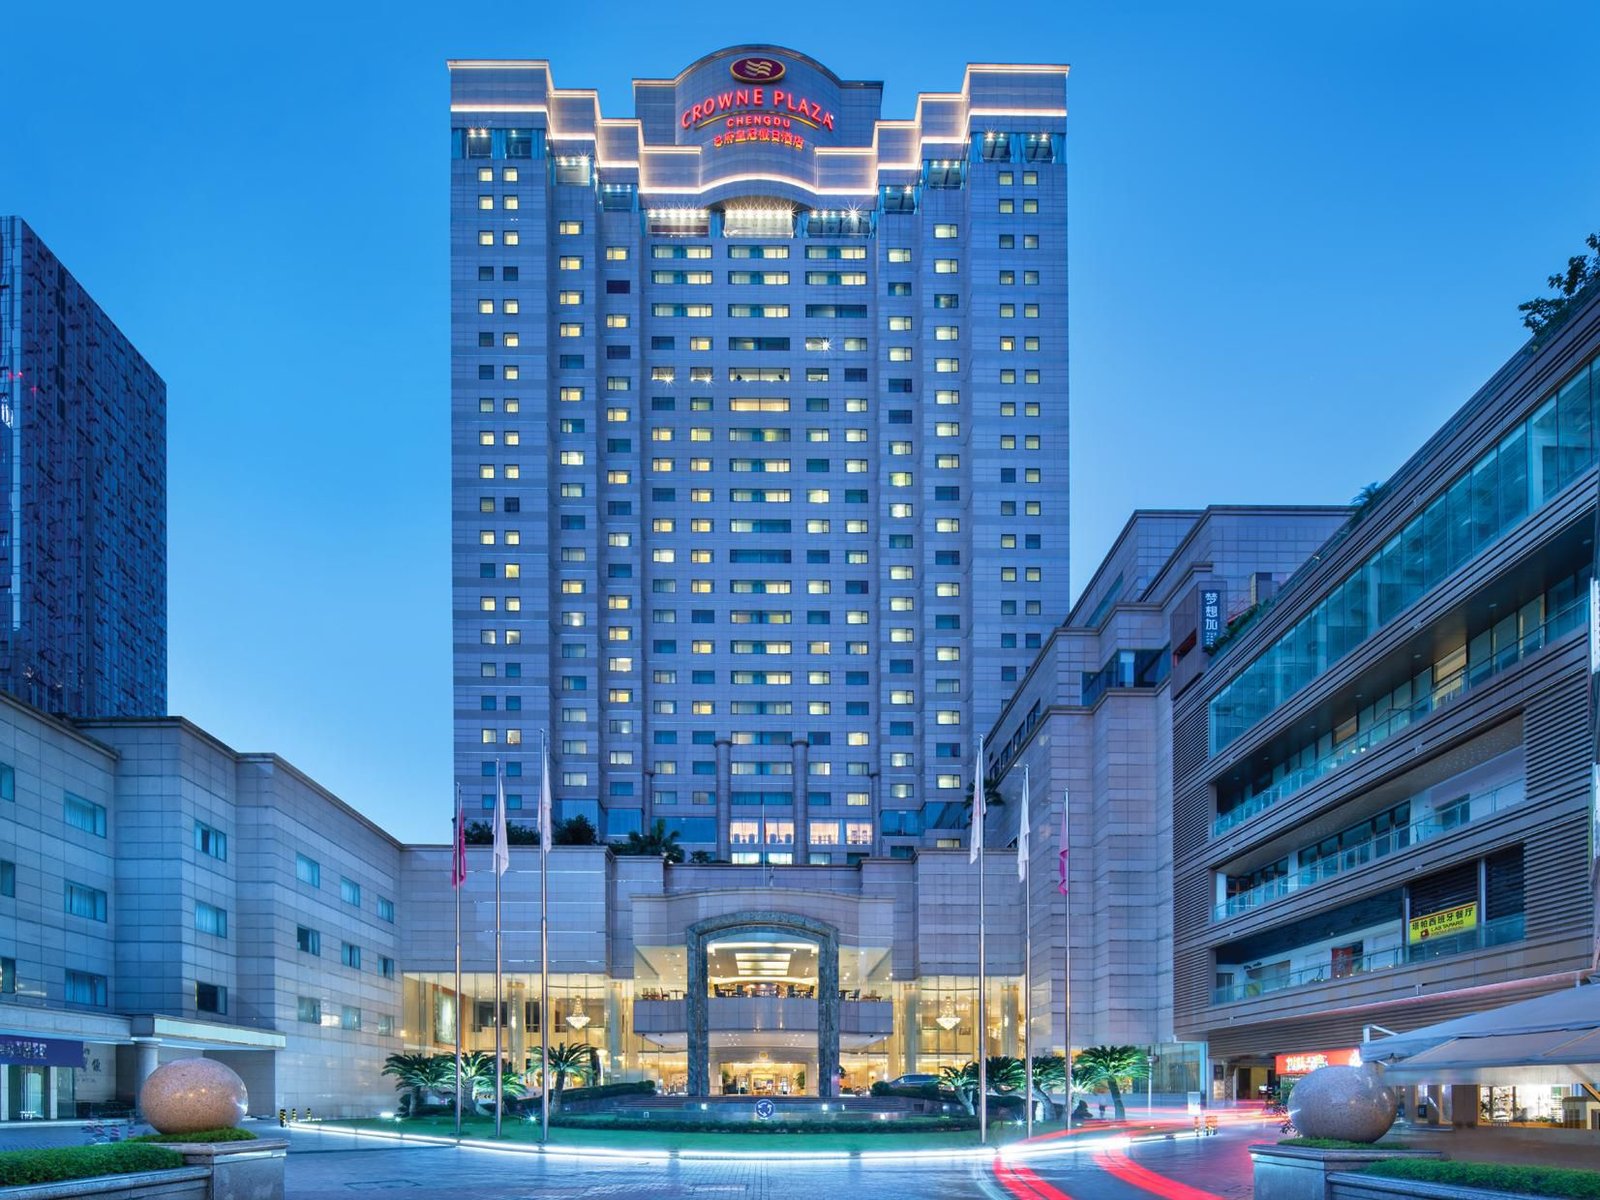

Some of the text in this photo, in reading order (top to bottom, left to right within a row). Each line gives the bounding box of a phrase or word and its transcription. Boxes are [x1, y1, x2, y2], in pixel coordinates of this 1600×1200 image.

[681, 88, 833, 130] CROWNE PLAZA
[727, 115, 790, 128] CHENGDU
[1205, 592, 1218, 630] 梦想加
